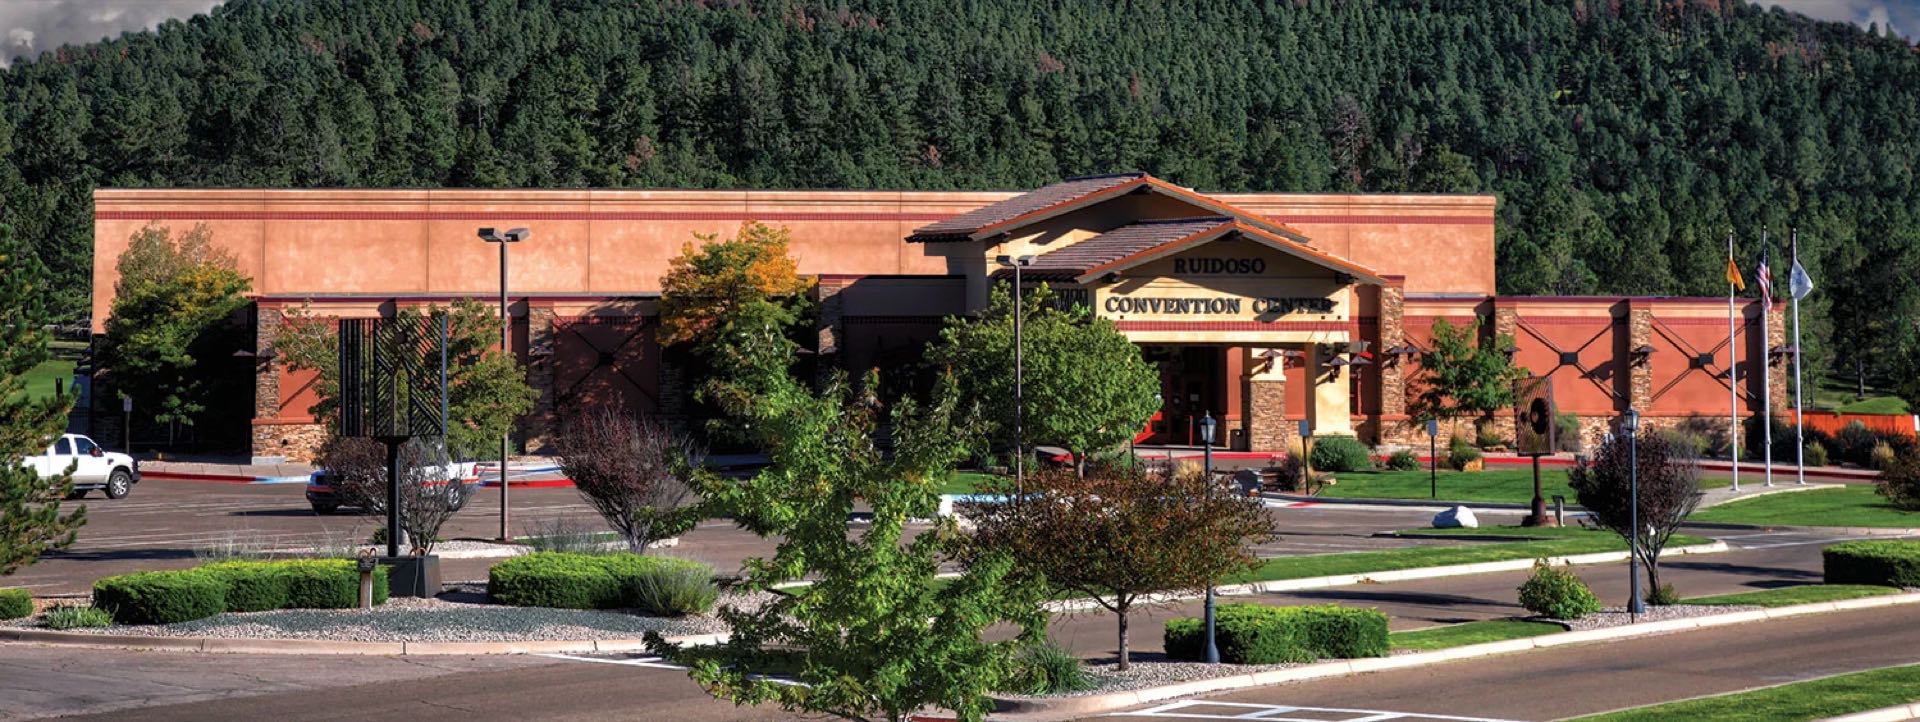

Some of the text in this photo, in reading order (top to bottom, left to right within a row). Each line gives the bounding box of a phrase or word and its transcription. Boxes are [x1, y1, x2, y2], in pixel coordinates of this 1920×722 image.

[1173, 257, 1266, 274] RUIDOSO
[1105, 296, 1333, 314] CONVENTION CENTER
